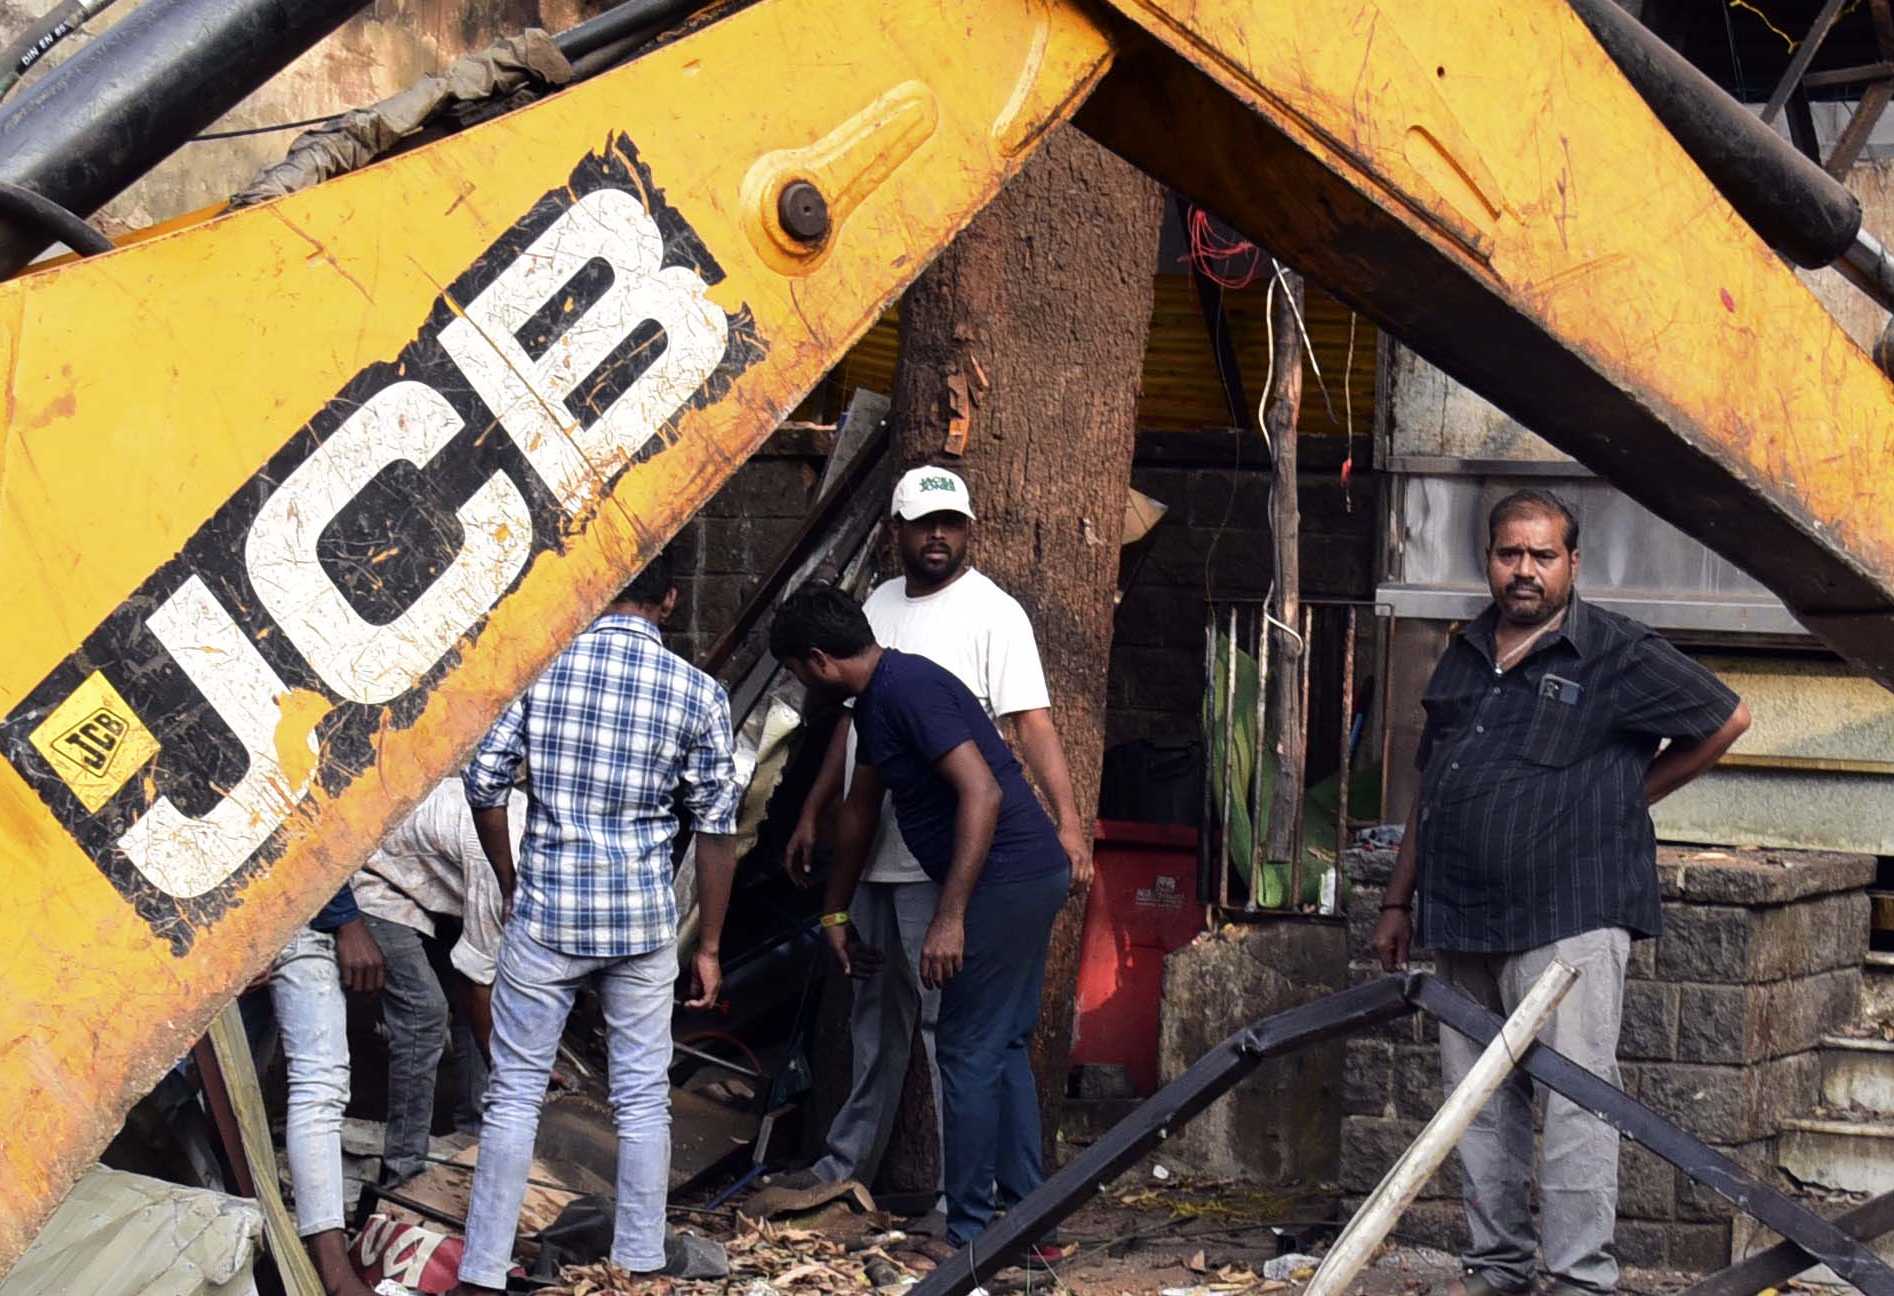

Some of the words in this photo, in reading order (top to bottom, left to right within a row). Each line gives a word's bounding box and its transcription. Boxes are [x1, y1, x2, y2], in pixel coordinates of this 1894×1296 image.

[21, 46, 40, 66] DIN
[38, 33, 54, 50] EN
[115, 187, 730, 899] JCB
[65, 713, 125, 771] JCB
